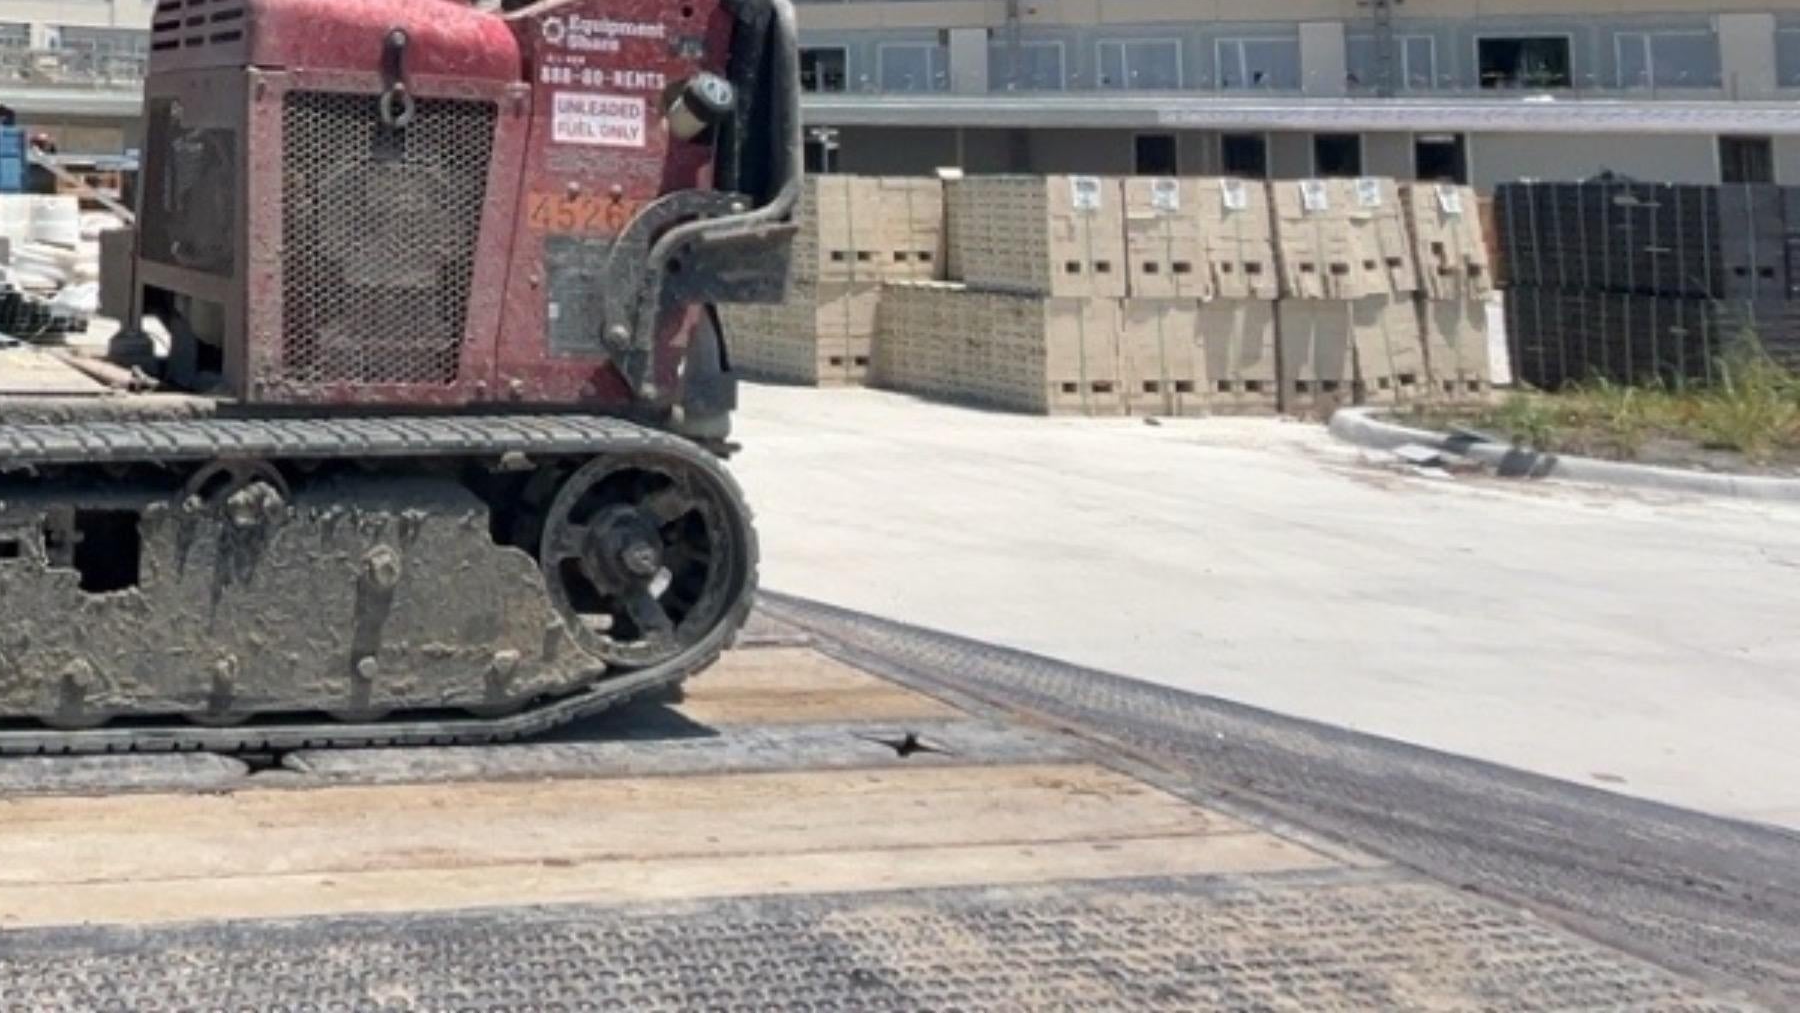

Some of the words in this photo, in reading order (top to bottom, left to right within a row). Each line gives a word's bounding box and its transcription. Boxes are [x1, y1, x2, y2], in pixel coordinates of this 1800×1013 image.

[568, 14, 665, 38] Equipment
[557, 98, 640, 119] UNLEADED
[557, 120, 594, 137] FUEL
[600, 122, 640, 139] ONLY
[530, 195, 641, 231] 4526
